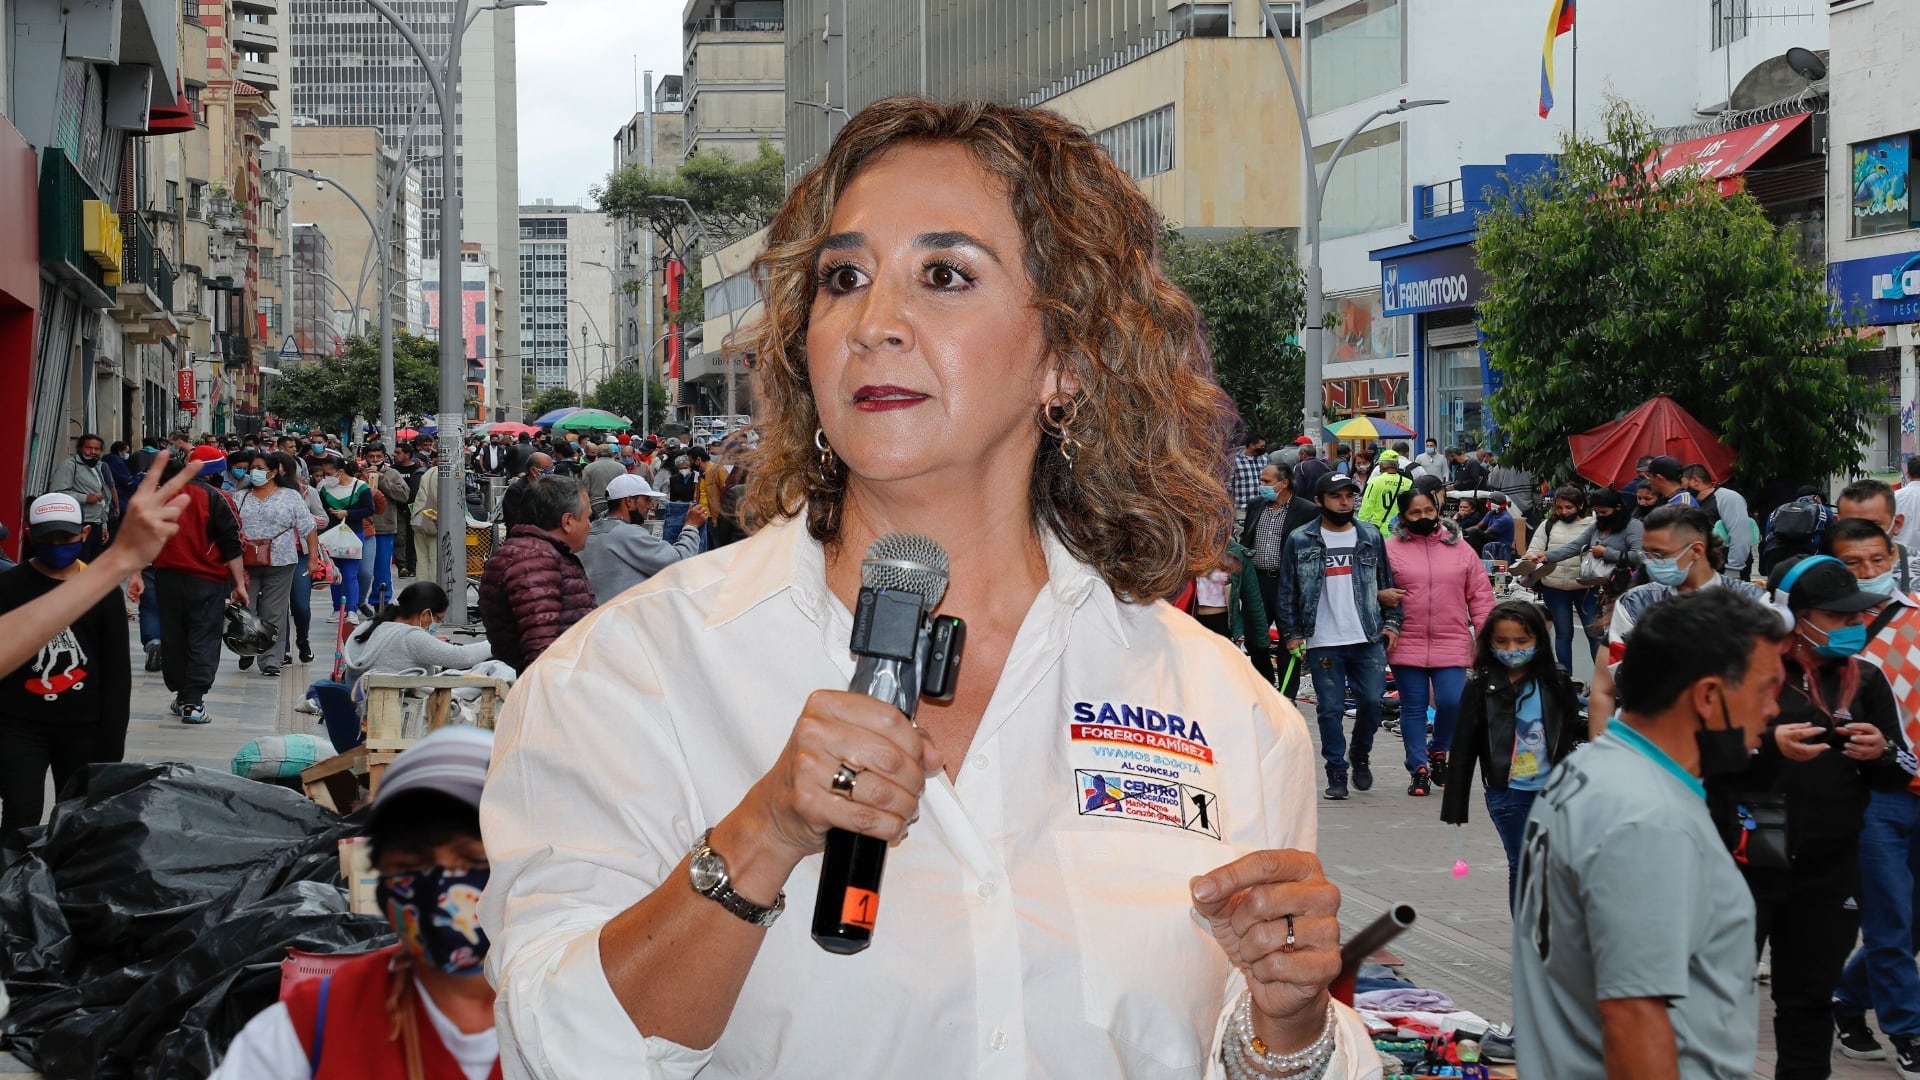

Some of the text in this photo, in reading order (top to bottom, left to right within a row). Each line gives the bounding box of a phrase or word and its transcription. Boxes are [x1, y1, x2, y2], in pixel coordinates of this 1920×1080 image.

[1399, 274, 1468, 309] FARMATODO
[1073, 702, 1208, 746] SANDRA
[1081, 727, 1207, 759] FORERO RAMÍREZ
[1092, 746, 1201, 775] VIVAMOS BOGOTÁ
[1121, 762, 1179, 779] AL CONCEJO
[1124, 780, 1178, 798] CENTRO
[1125, 799, 1169, 813] Mano firme
[1125, 807, 1156, 819] Corazón
[1191, 793, 1209, 829] 1
[851, 894, 872, 925] 1
